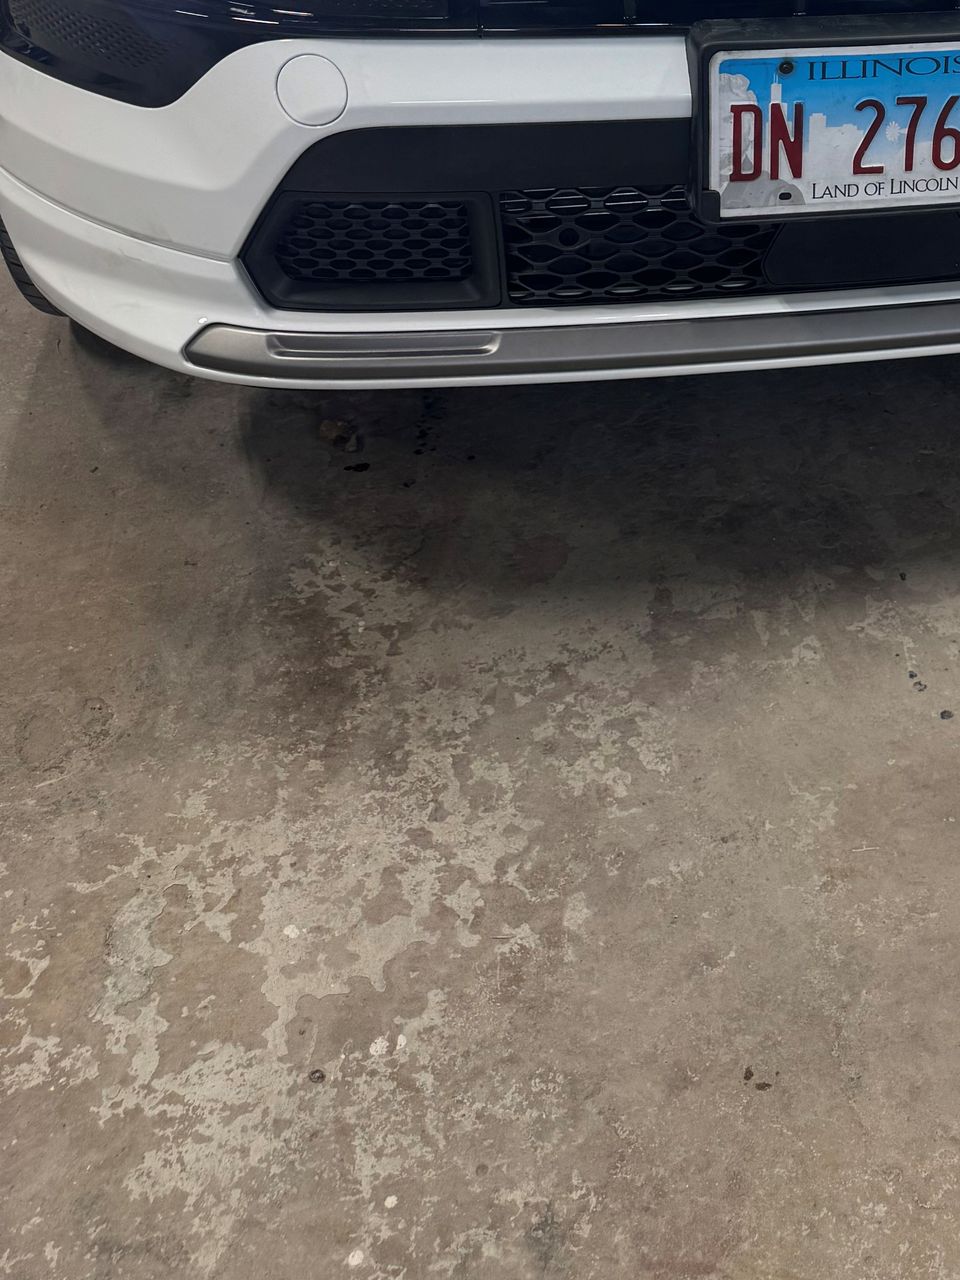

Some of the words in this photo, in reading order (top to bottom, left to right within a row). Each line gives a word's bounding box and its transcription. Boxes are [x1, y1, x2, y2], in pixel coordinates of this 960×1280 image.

[729, 102, 804, 182] DN
[812, 182, 860, 200] LAND
[864, 181, 885, 197] OF
[890, 176, 959, 195] LINCOLN
